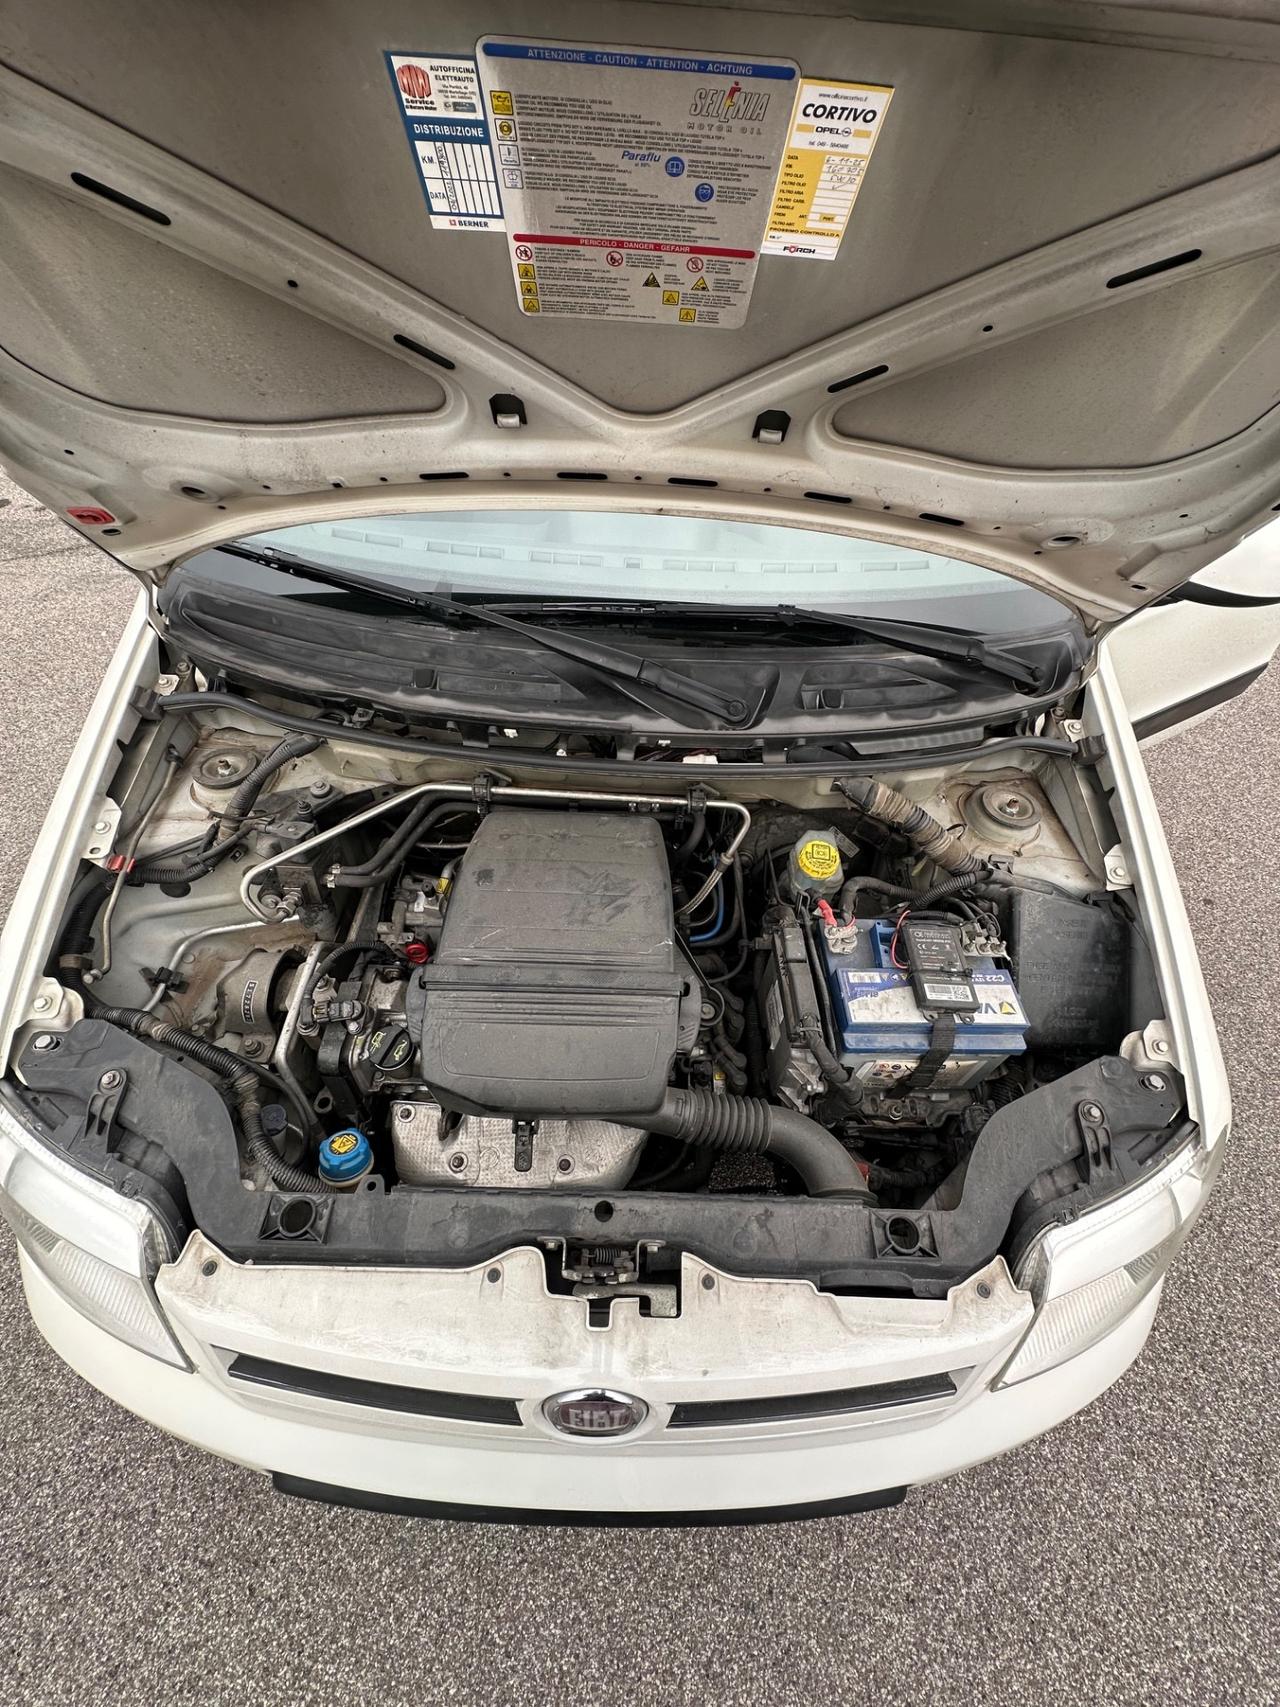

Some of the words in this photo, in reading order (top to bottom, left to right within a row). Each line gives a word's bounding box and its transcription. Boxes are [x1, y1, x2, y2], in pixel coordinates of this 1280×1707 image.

[527, 48, 586, 62] ATTENZIONE
[595, 54, 638, 67] CAUTION
[646, 58, 698, 71] ATTENTION
[706, 63, 753, 76] ACHTUNG
[430, 65, 475, 74] AUTOFFICINA
[434, 75, 474, 83] ELETTRAUTO
[689, 82, 770, 123] SELENIA
[802, 103, 877, 123] CORTIVO
[413, 124, 484, 137] DISTRIBUZIONE
[687, 122, 733, 134] MOTOR
[741, 126, 763, 136] OIL
[815, 126, 841, 135] OPEL
[421, 155, 437, 164] KM.
[621, 150, 662, 163] Paraflu
[429, 192, 446, 200] DATA
[458, 220, 489, 228] BERNER
[580, 238, 618, 248] PERICOLO
[623, 242, 655, 250] DANGER
[661, 244, 691, 253] GEFAHR
[985, 974, 1005, 982] C22
[568, 1408, 626, 1428] FIAT
